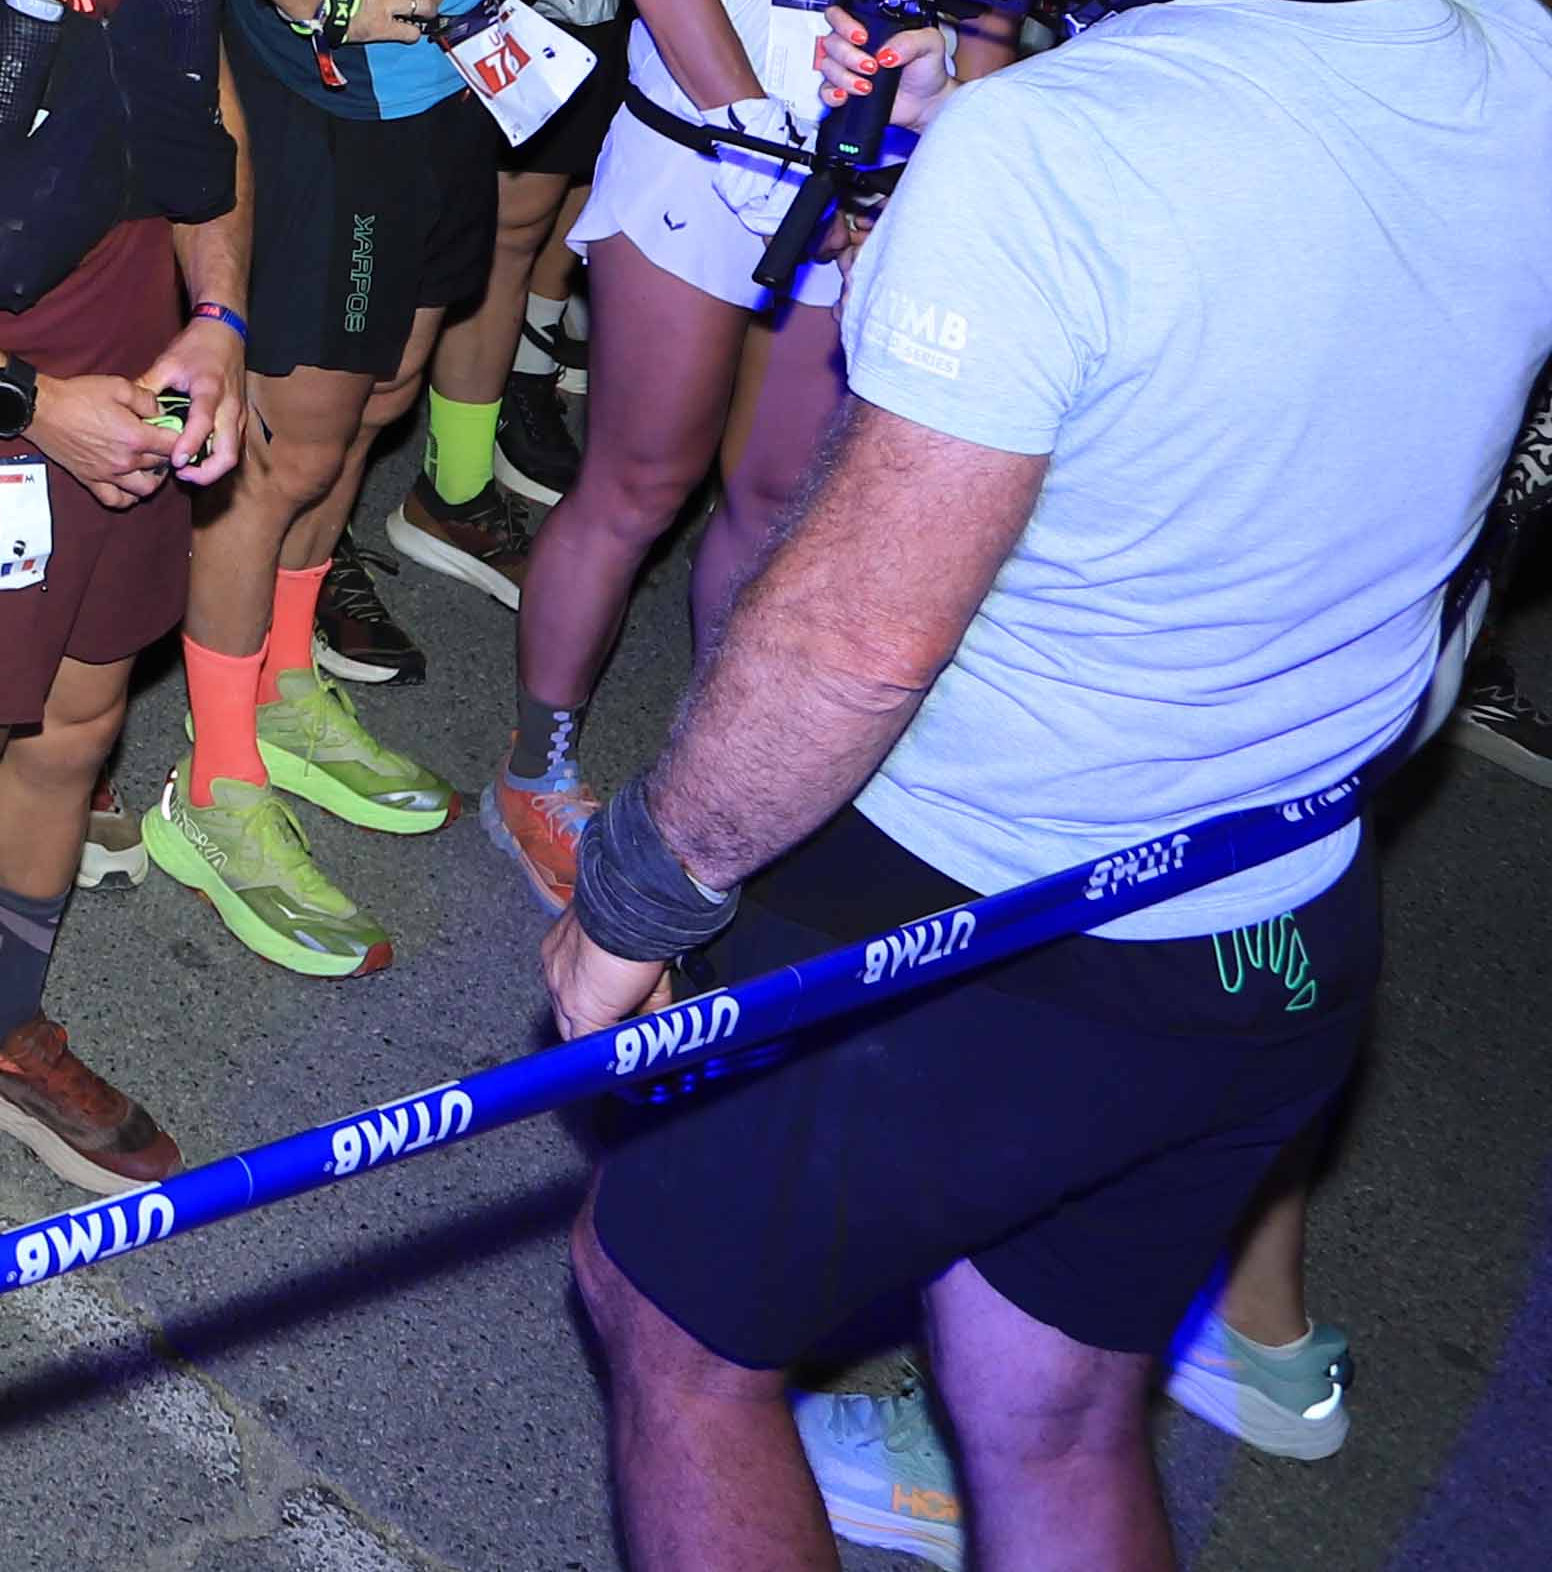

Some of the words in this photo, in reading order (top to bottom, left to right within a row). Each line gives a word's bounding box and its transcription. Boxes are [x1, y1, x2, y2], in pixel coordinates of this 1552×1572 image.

[863, 910, 977, 985] UTMB
[615, 995, 741, 1076] UTMB
[332, 1088, 473, 1176] UTMB
[15, 1192, 175, 1285] UTMB
